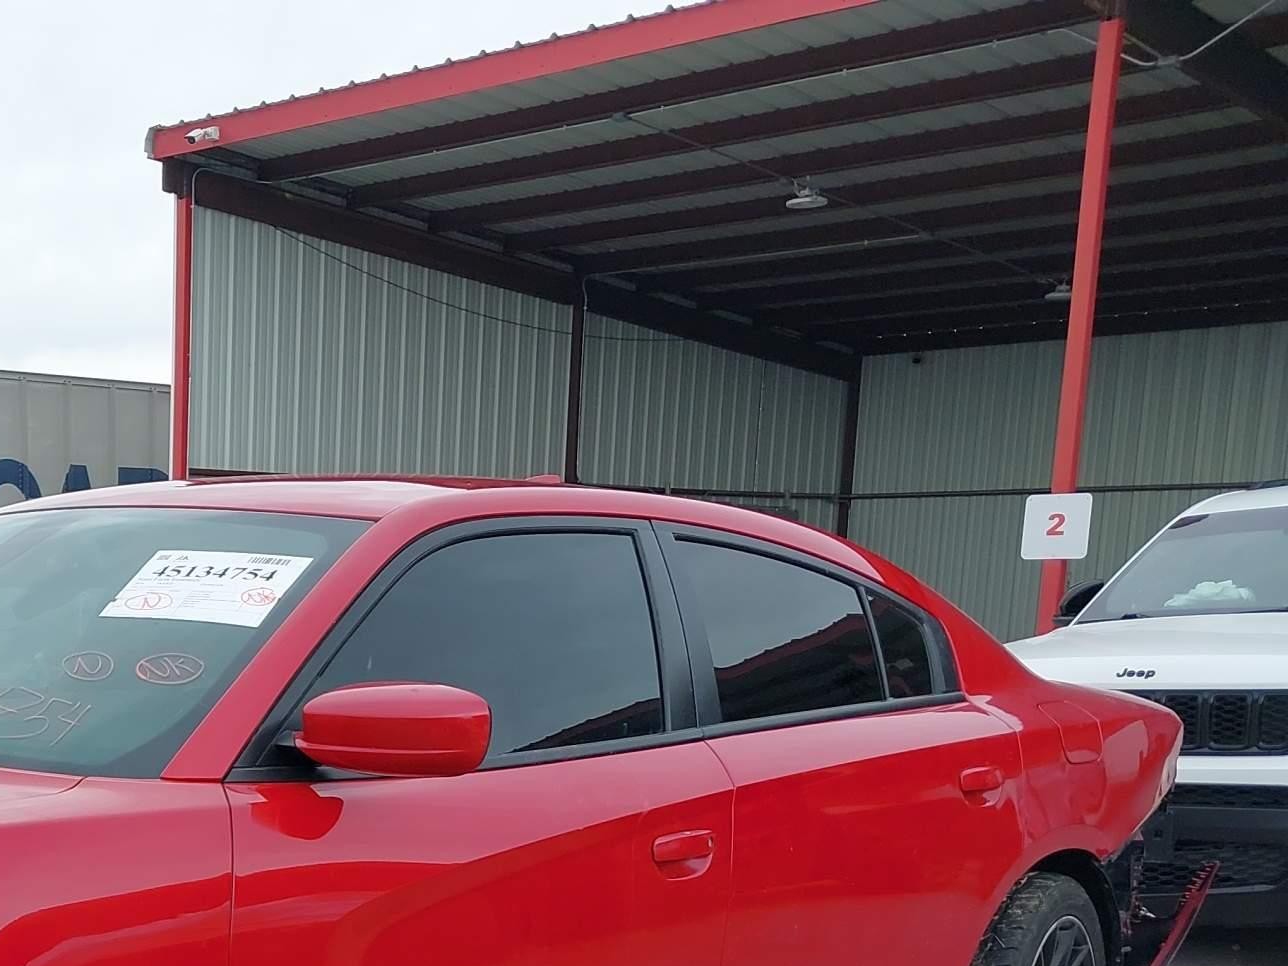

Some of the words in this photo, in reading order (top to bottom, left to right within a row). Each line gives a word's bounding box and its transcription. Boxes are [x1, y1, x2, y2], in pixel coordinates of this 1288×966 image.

[1045, 512, 1066, 537] 2
[152, 564, 278, 582] 45134754
[1115, 667, 1156, 680] Jeep
